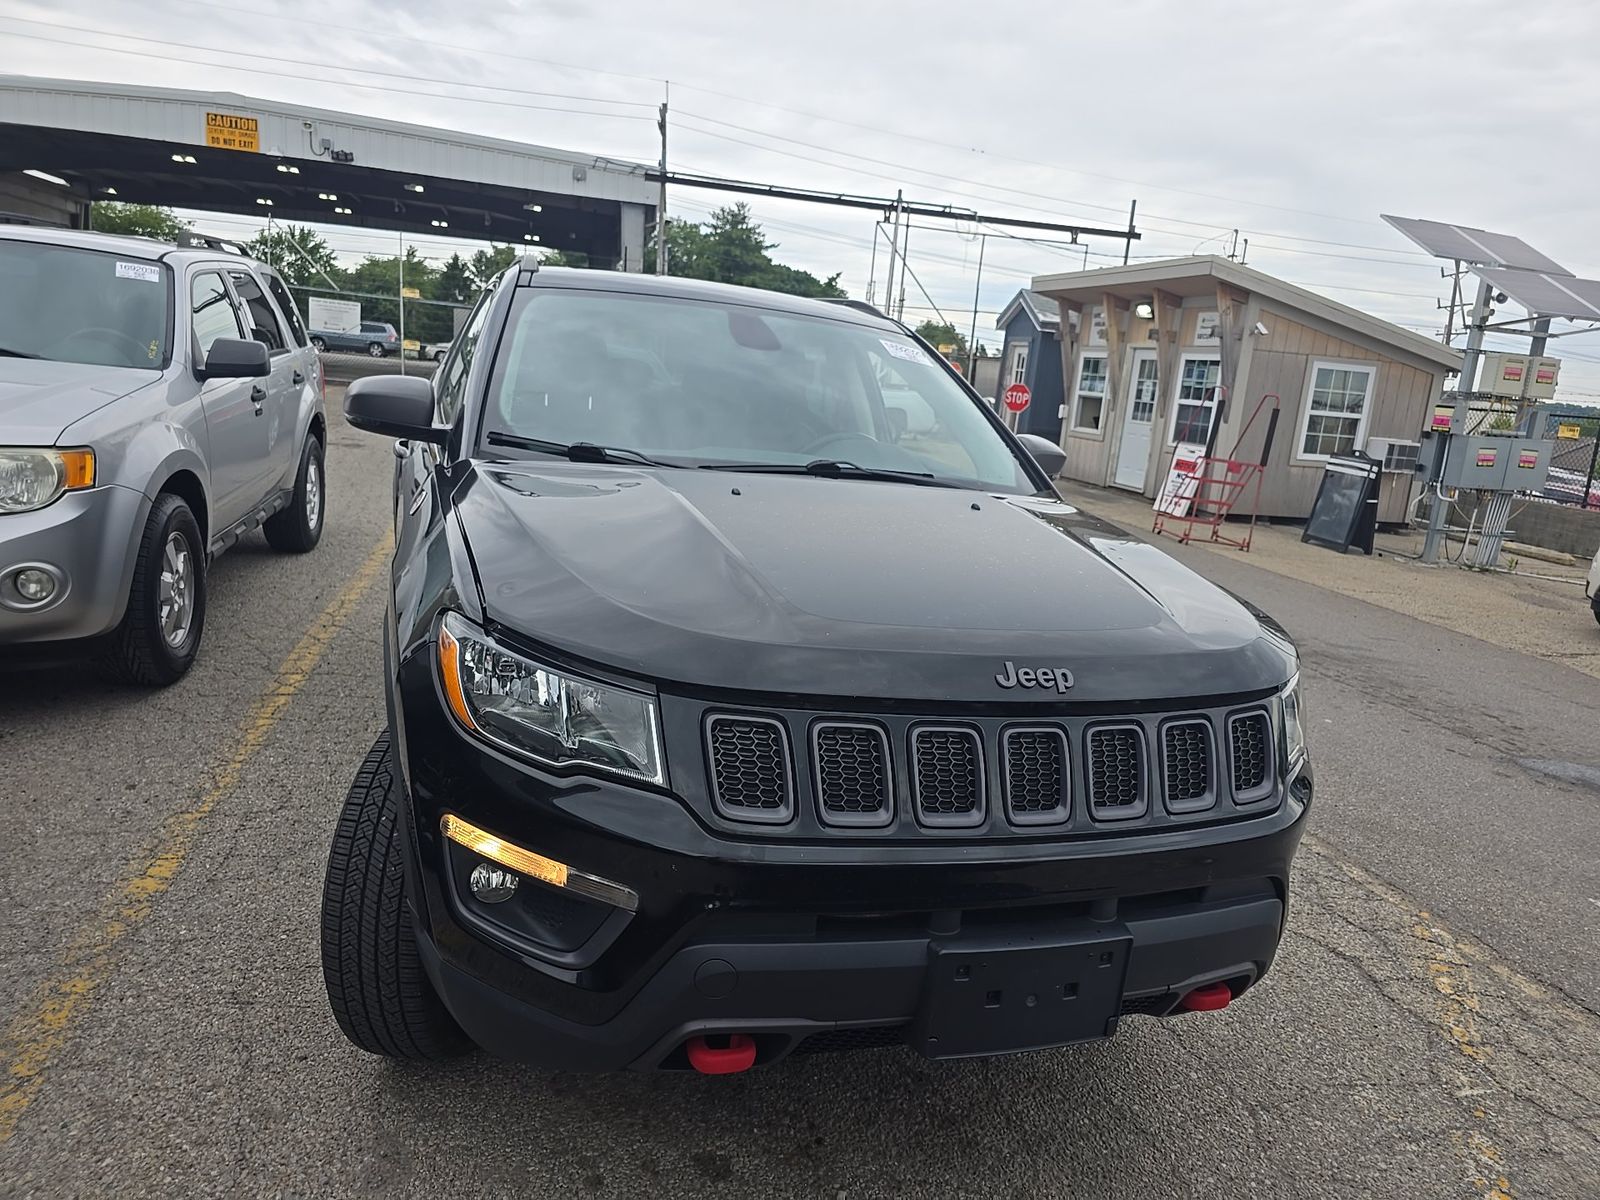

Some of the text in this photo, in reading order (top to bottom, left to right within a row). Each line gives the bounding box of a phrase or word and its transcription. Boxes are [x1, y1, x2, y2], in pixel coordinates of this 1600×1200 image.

[208, 114, 257, 131] CAUTION
[211, 136, 254, 149] DO NOT EXIT
[1005, 391, 1030, 405] STOP
[995, 661, 1075, 694] Jeep
